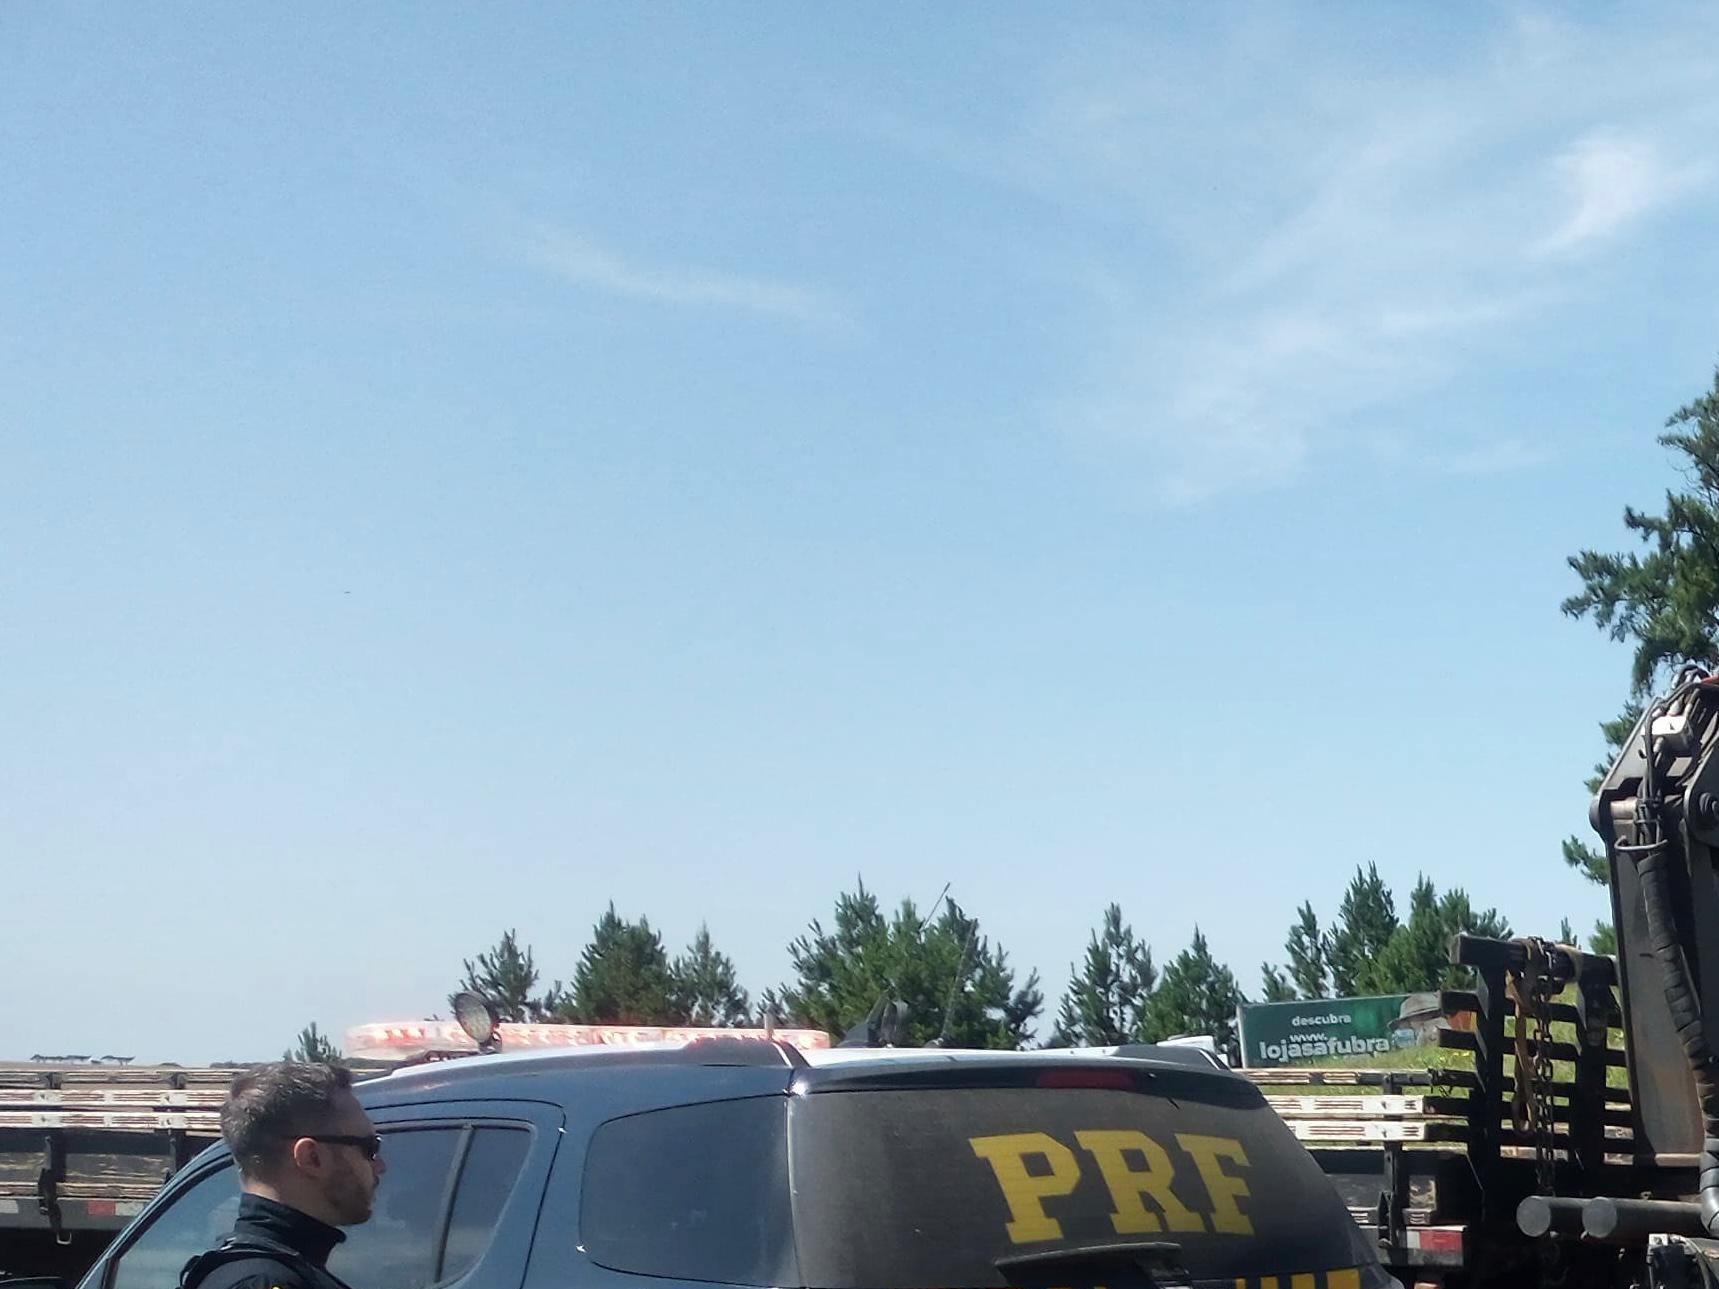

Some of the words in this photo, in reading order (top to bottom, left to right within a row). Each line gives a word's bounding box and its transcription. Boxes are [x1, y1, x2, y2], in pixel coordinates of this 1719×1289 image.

[1291, 1013, 1352, 1027] descubra
[1259, 1035, 1391, 1063] lojasafubra
[969, 1129, 1255, 1244] PRF
